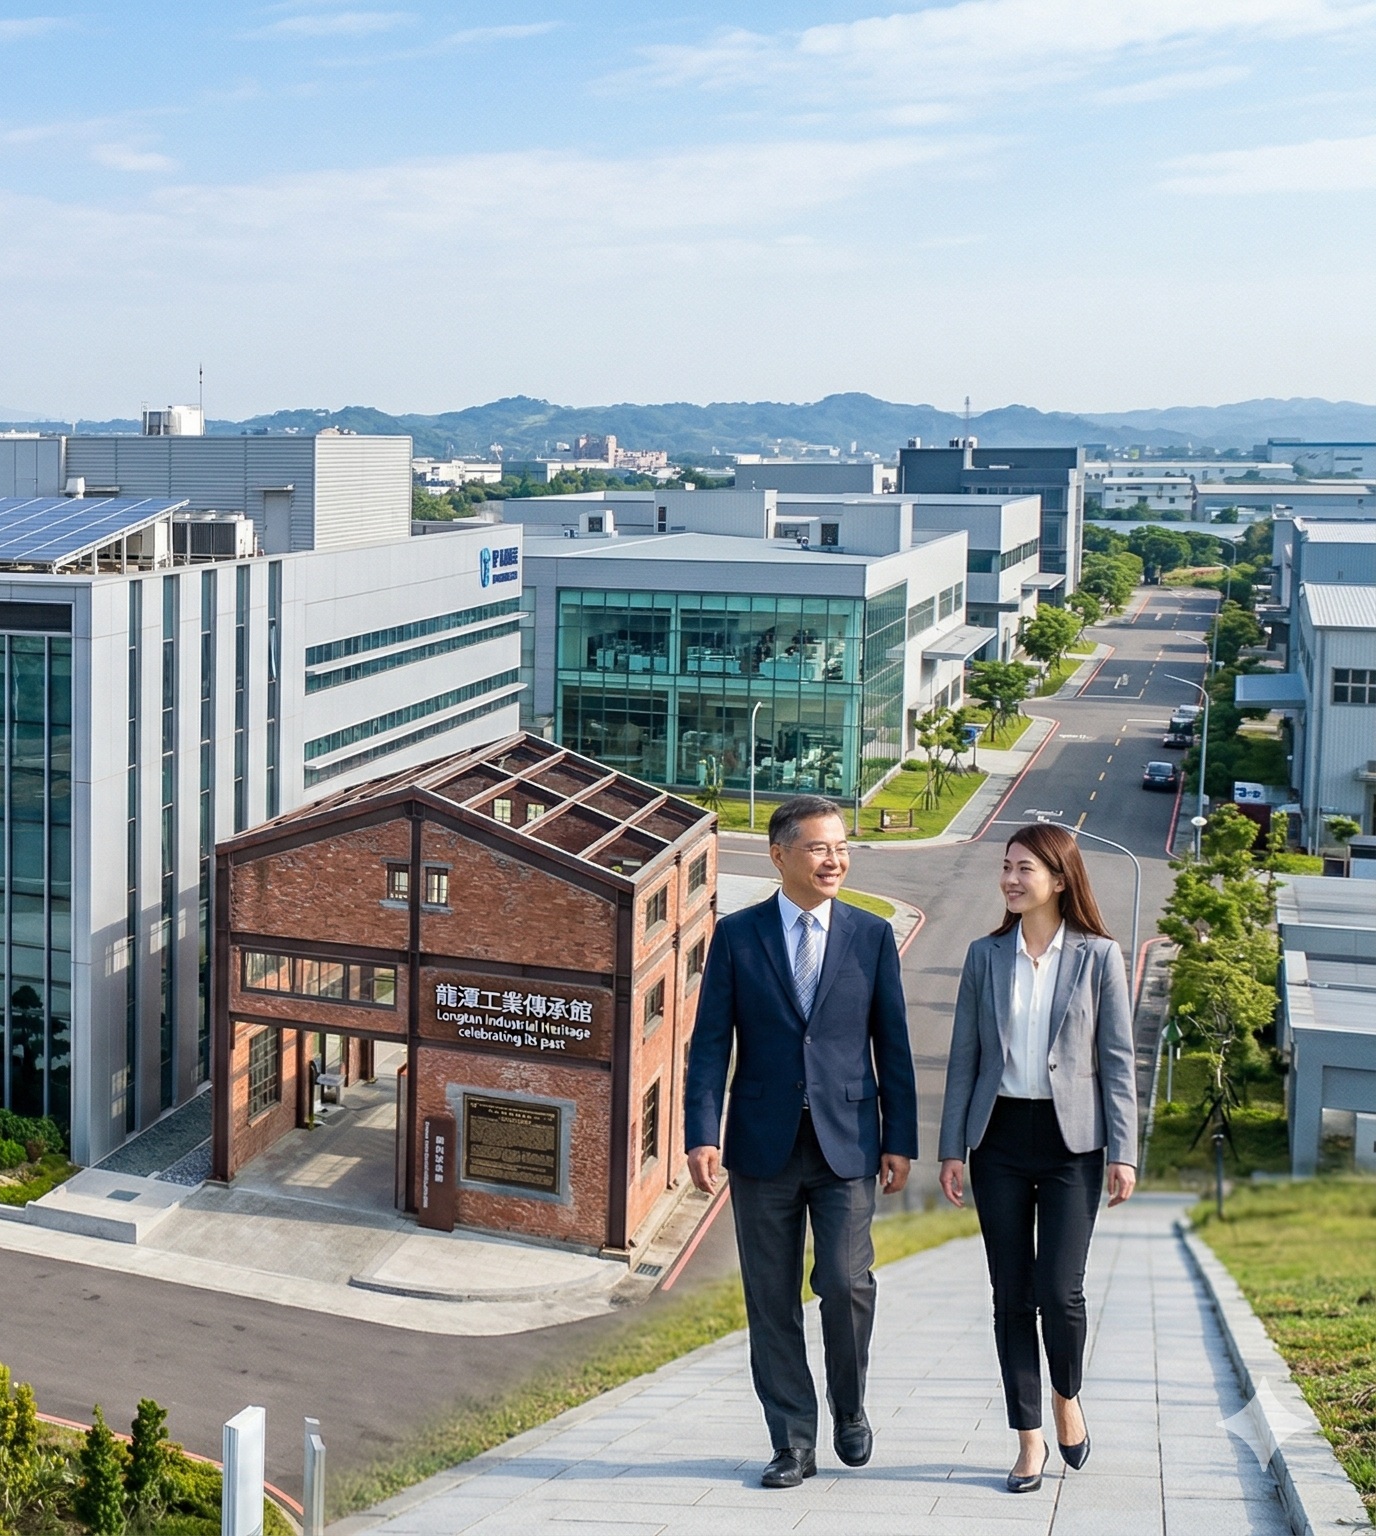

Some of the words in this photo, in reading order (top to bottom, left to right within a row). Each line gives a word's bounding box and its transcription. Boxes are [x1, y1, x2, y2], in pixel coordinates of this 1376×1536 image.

[435, 983, 593, 1023] 龍潭工業傳承館
[458, 1026, 522, 1047] celebrating
